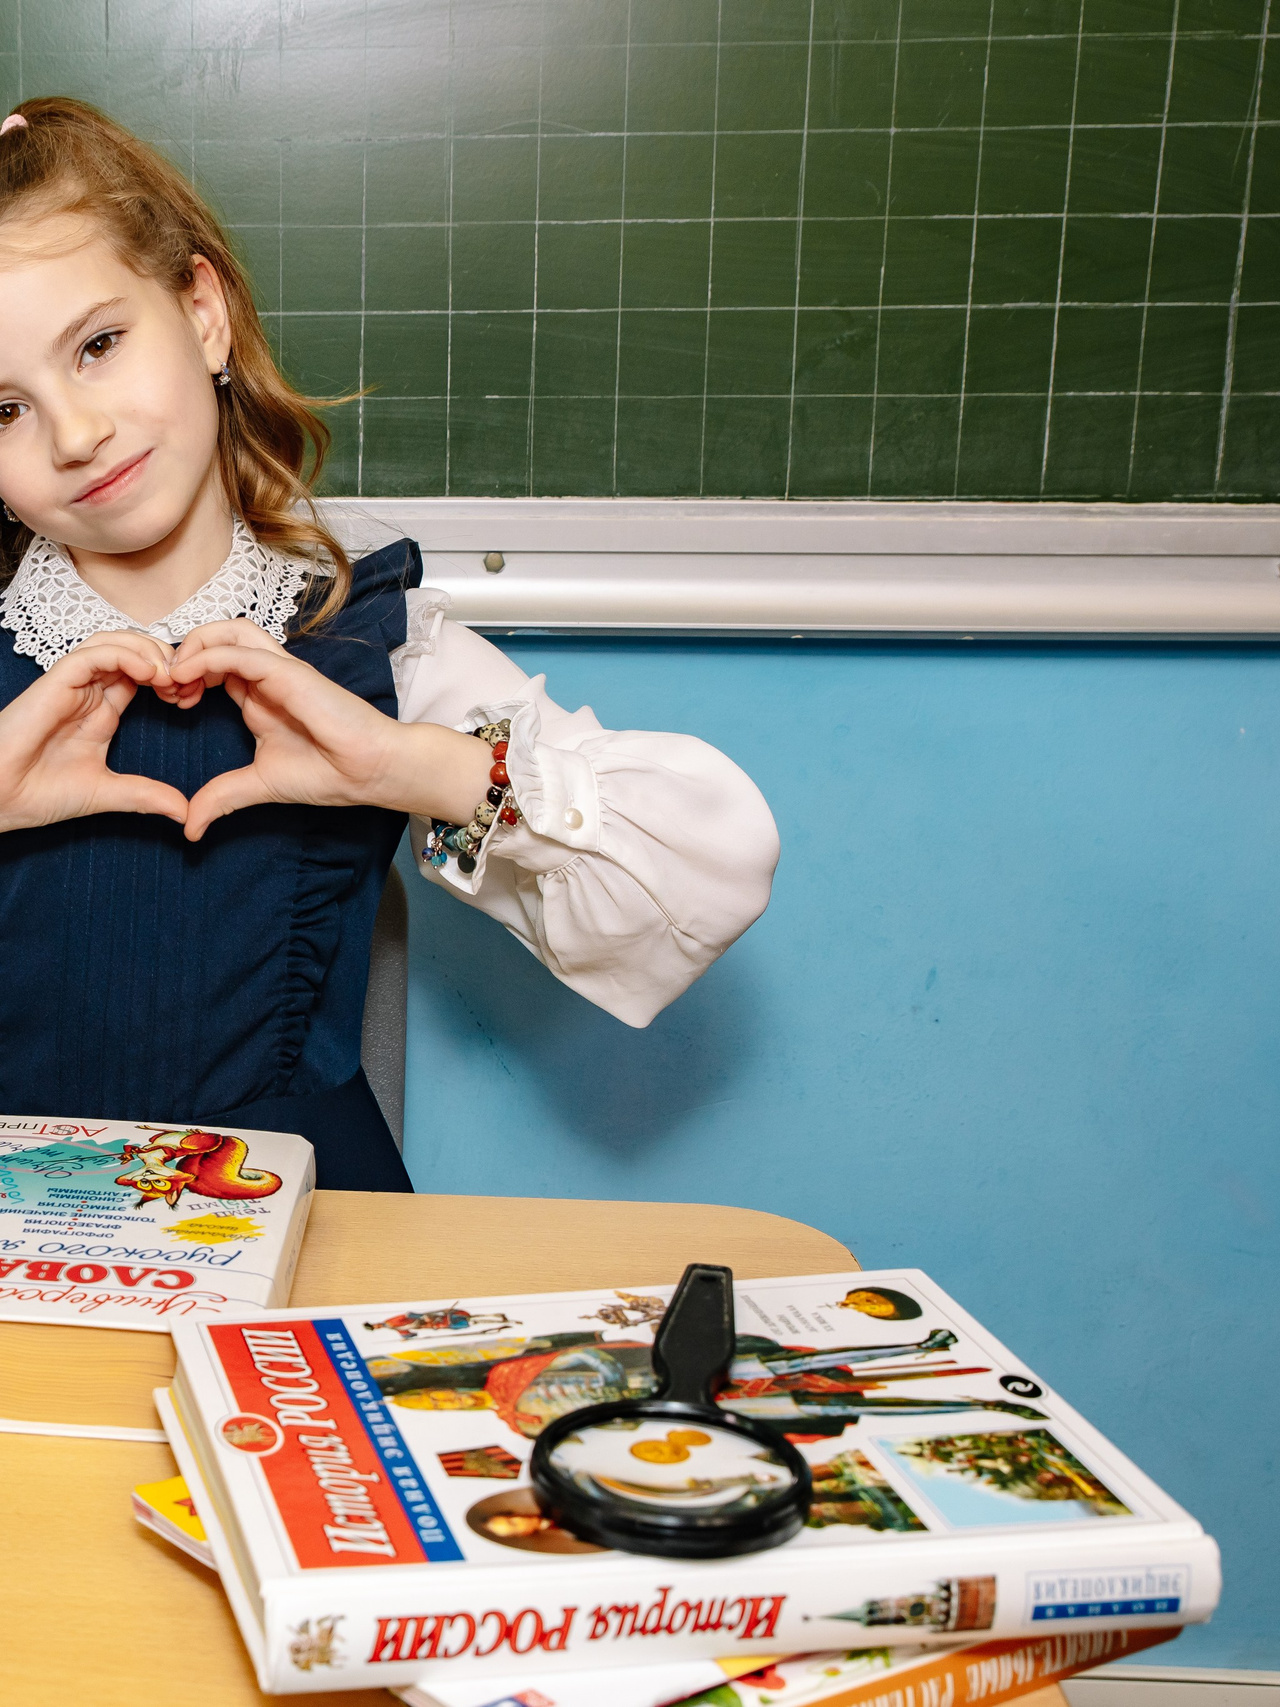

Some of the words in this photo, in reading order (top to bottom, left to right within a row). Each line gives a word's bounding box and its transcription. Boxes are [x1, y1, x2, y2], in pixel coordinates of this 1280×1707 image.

[45, 1187, 120, 1197] АНТОНИМЫ
[48, 1193, 125, 1203] СИНОНИМЫ
[37, 1201, 127, 1212] ЭТИМОЛОГИЯ
[69, 1211, 156, 1223] ТОЛКОВАНИЕ
[212, 1207, 271, 1218] темп
[21, 1227, 114, 1239] ОРФОГРАФИЯ
[23, 1218, 122, 1230] ФРАЗЕОЛОГИЯ
[38, 1242, 242, 1267] русского
[240, 1327, 338, 1430] РОССИИ
[325, 1332, 405, 1460] ЭНЦИКЛОПЕДИЯ
[299, 1433, 397, 1558] История
[391, 1465, 447, 1544] ПОЛНАЯ
[1032, 1569, 1182, 1601] ЭНЦИКЛОПЕДИЯ
[586, 1587, 787, 1641] История
[366, 1607, 578, 1664] РОССИИ
